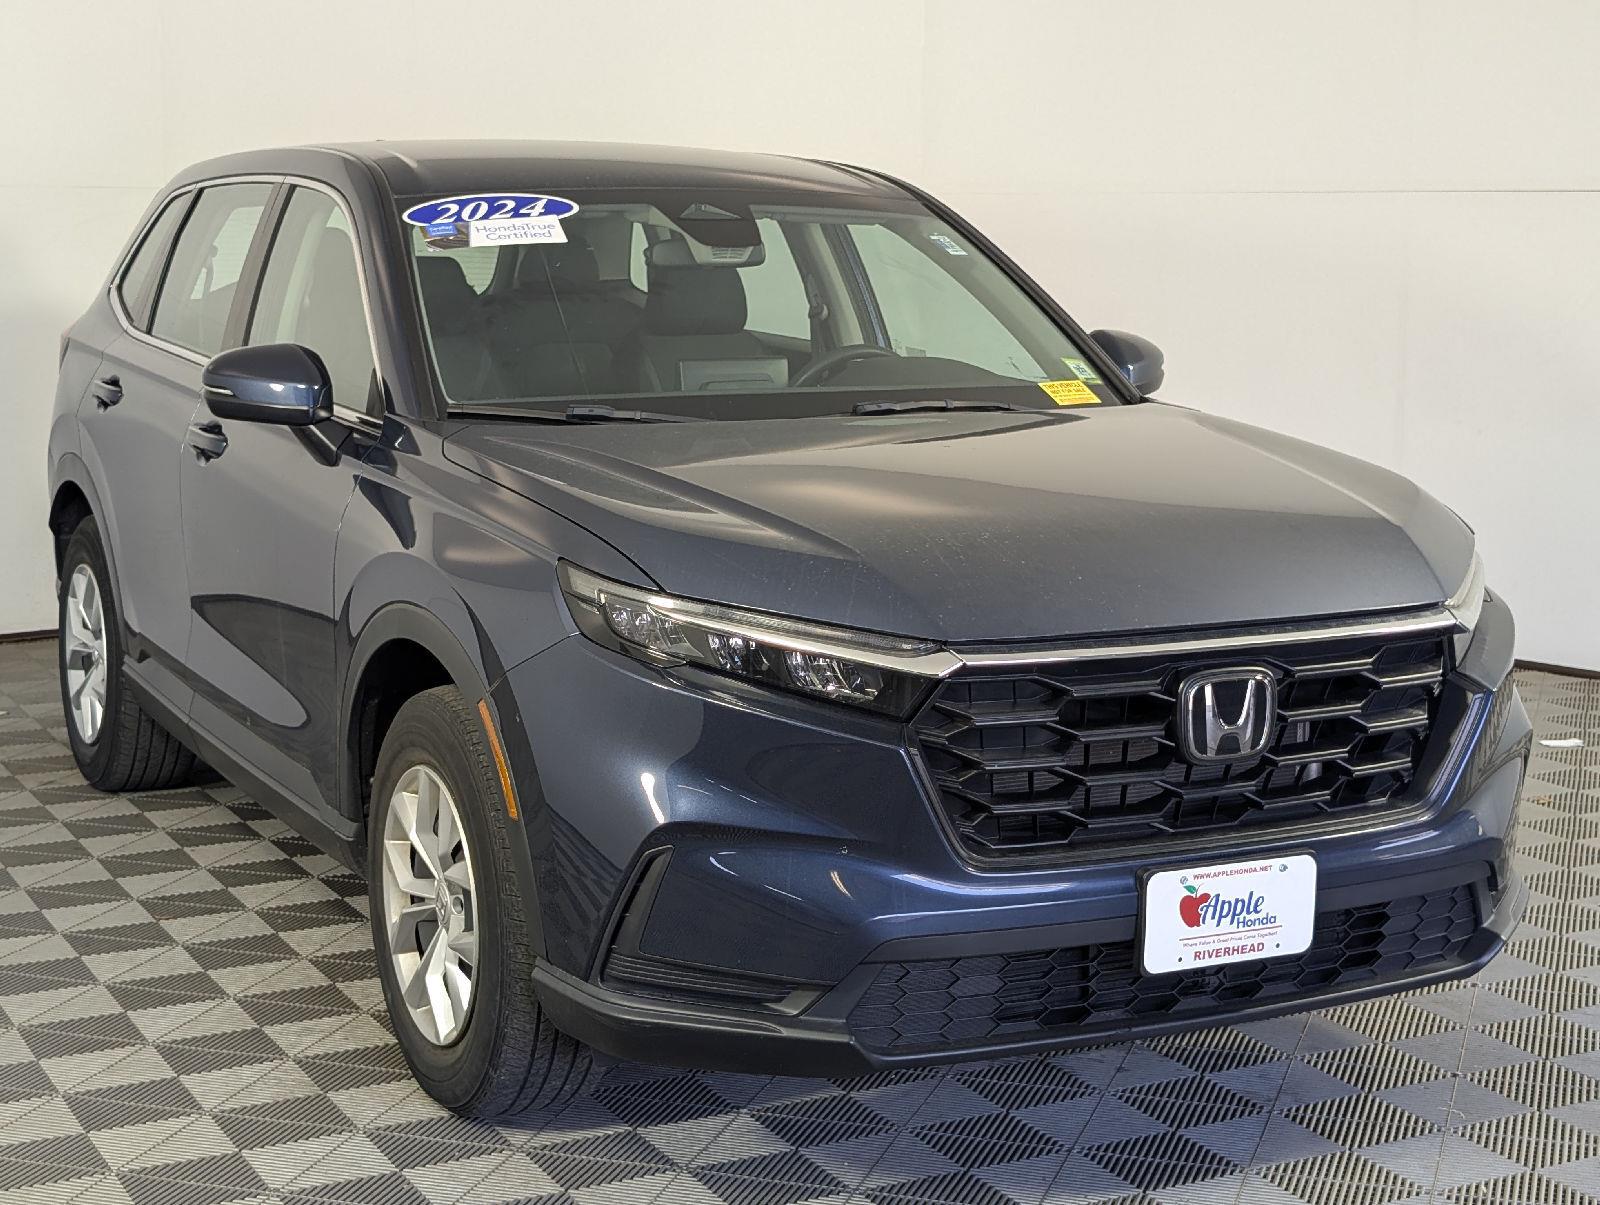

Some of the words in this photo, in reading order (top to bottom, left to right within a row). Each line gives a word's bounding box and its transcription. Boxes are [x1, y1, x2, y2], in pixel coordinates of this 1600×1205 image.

[430, 198, 548, 225] 2024
[474, 222, 557, 233] HondaTrue
[486, 230, 552, 241] Certified
[1193, 864, 1273, 881] WWW.APPLEHONDA.NET
[1199, 890, 1265, 927] Apple
[1236, 912, 1277, 929] Honda
[1193, 942, 1265, 961] RIVERHEAD
